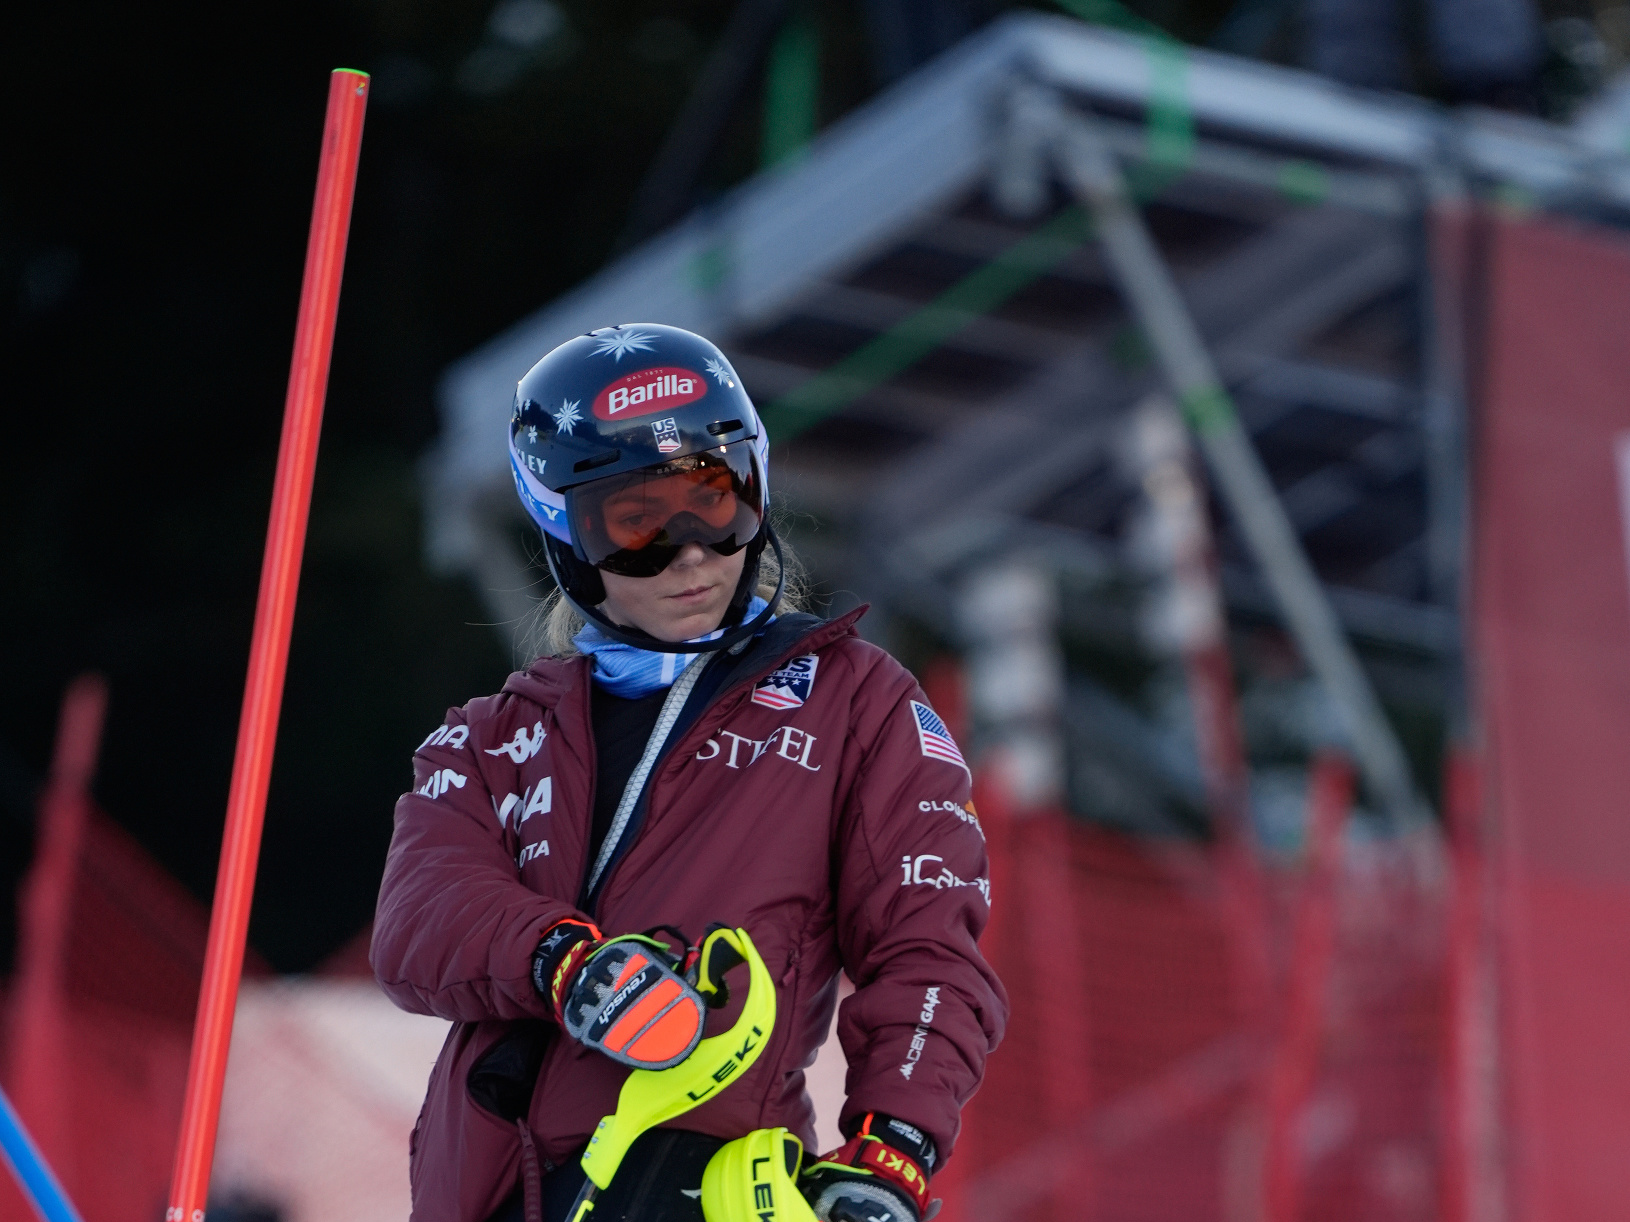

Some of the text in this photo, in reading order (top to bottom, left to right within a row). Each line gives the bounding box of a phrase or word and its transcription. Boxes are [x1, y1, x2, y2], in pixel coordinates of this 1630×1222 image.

[608, 374, 694, 415] Barilla
[653, 419, 675, 434] US
[599, 971, 648, 1026] reusch
[686, 1026, 763, 1102] LEKI
[876, 1149, 927, 1196] LEKI
